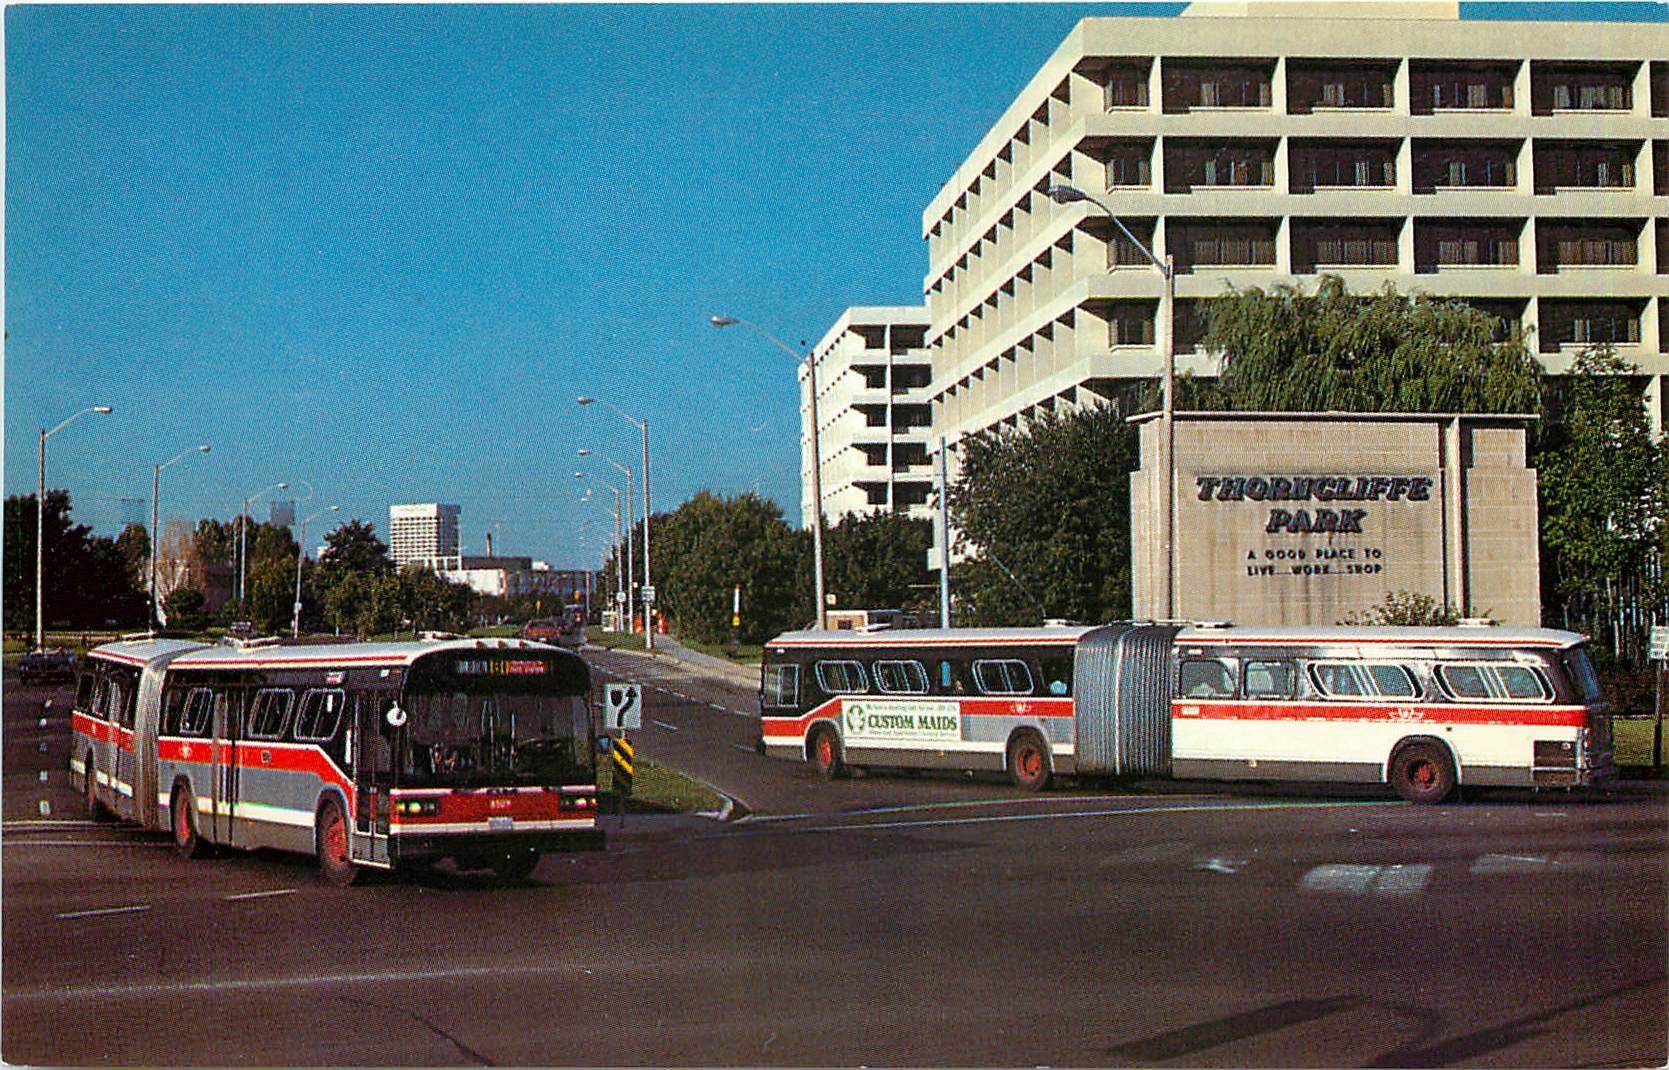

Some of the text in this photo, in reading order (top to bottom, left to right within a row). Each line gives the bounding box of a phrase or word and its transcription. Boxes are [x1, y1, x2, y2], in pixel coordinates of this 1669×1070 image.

[1196, 477, 1433, 502] THORNCLIFFE
[1265, 508, 1368, 533] PARK
[1247, 548, 1382, 560] A GOOD PLACE TO
[1346, 564, 1382, 574] SHOP
[867, 714, 958, 732] CUSTOM MAIDS
